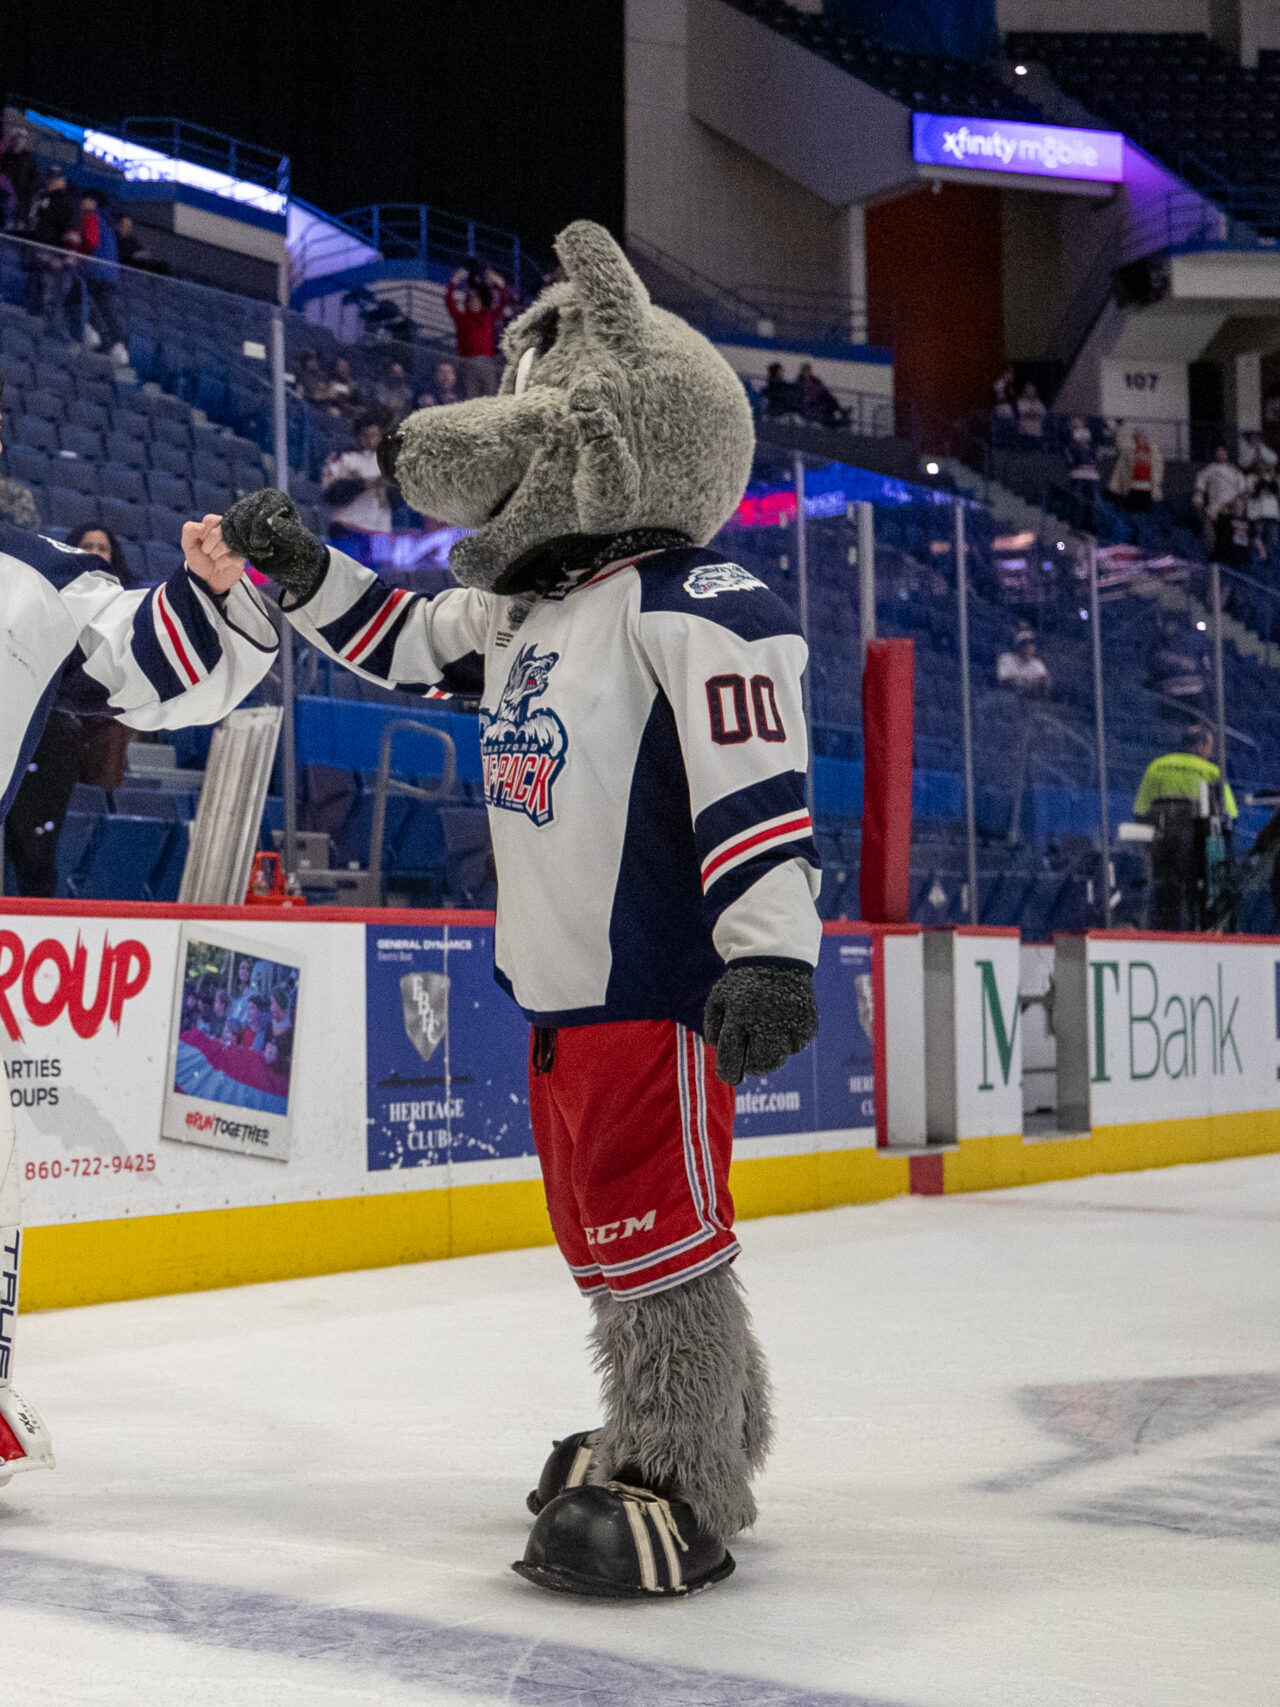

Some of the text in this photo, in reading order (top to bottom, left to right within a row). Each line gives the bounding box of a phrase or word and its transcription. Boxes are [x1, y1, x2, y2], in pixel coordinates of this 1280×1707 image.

[943, 126, 1017, 165] xfinity
[1125, 371, 1158, 391] 107
[705, 673, 786, 745] 00
[377, 939, 472, 951] GENERAL DYNAMICS
[389, 1099, 464, 1122] HERITAGE
[407, 1129, 451, 1150] CLUB
[24, 1153, 157, 1181] 860-722-9425
[584, 1209, 657, 1246] CCM
